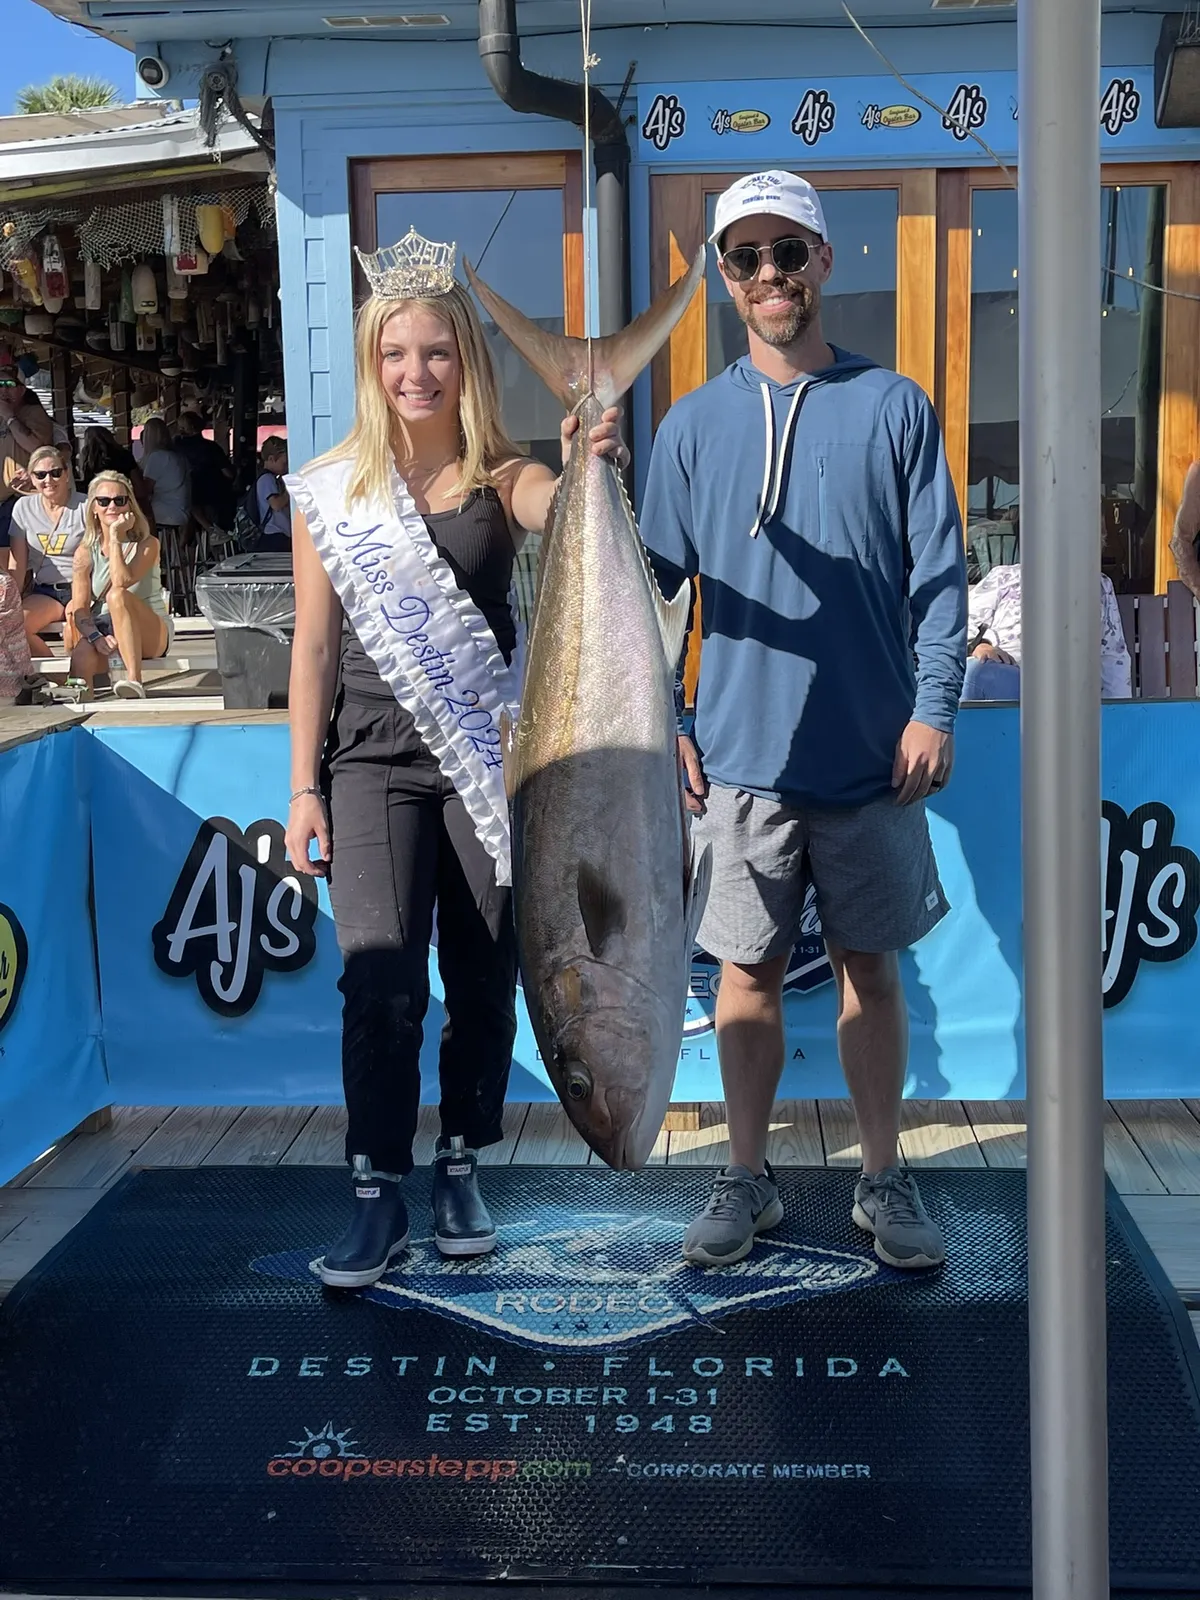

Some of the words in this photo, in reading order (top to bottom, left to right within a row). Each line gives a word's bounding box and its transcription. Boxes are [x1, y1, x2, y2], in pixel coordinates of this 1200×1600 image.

[336, 521, 395, 595] Miss
[380, 596, 454, 691] Destin
[443, 690, 503, 771] 2024
[1101, 816, 1187, 994] J's
[800, 946, 820, 954] 1-31
[495, 1292, 674, 1315] RODEO
[247, 1355, 497, 1377] DESTIN
[602, 1357, 911, 1378] FLORIDA
[427, 1386, 628, 1405] OCTOBER
[646, 1387, 718, 1406] 1-31
[426, 1413, 542, 1433] EST.
[584, 1414, 713, 1433] 1948
[627, 1463, 766, 1479] CORPORATE
[772, 1463, 872, 1479] MEMBER
